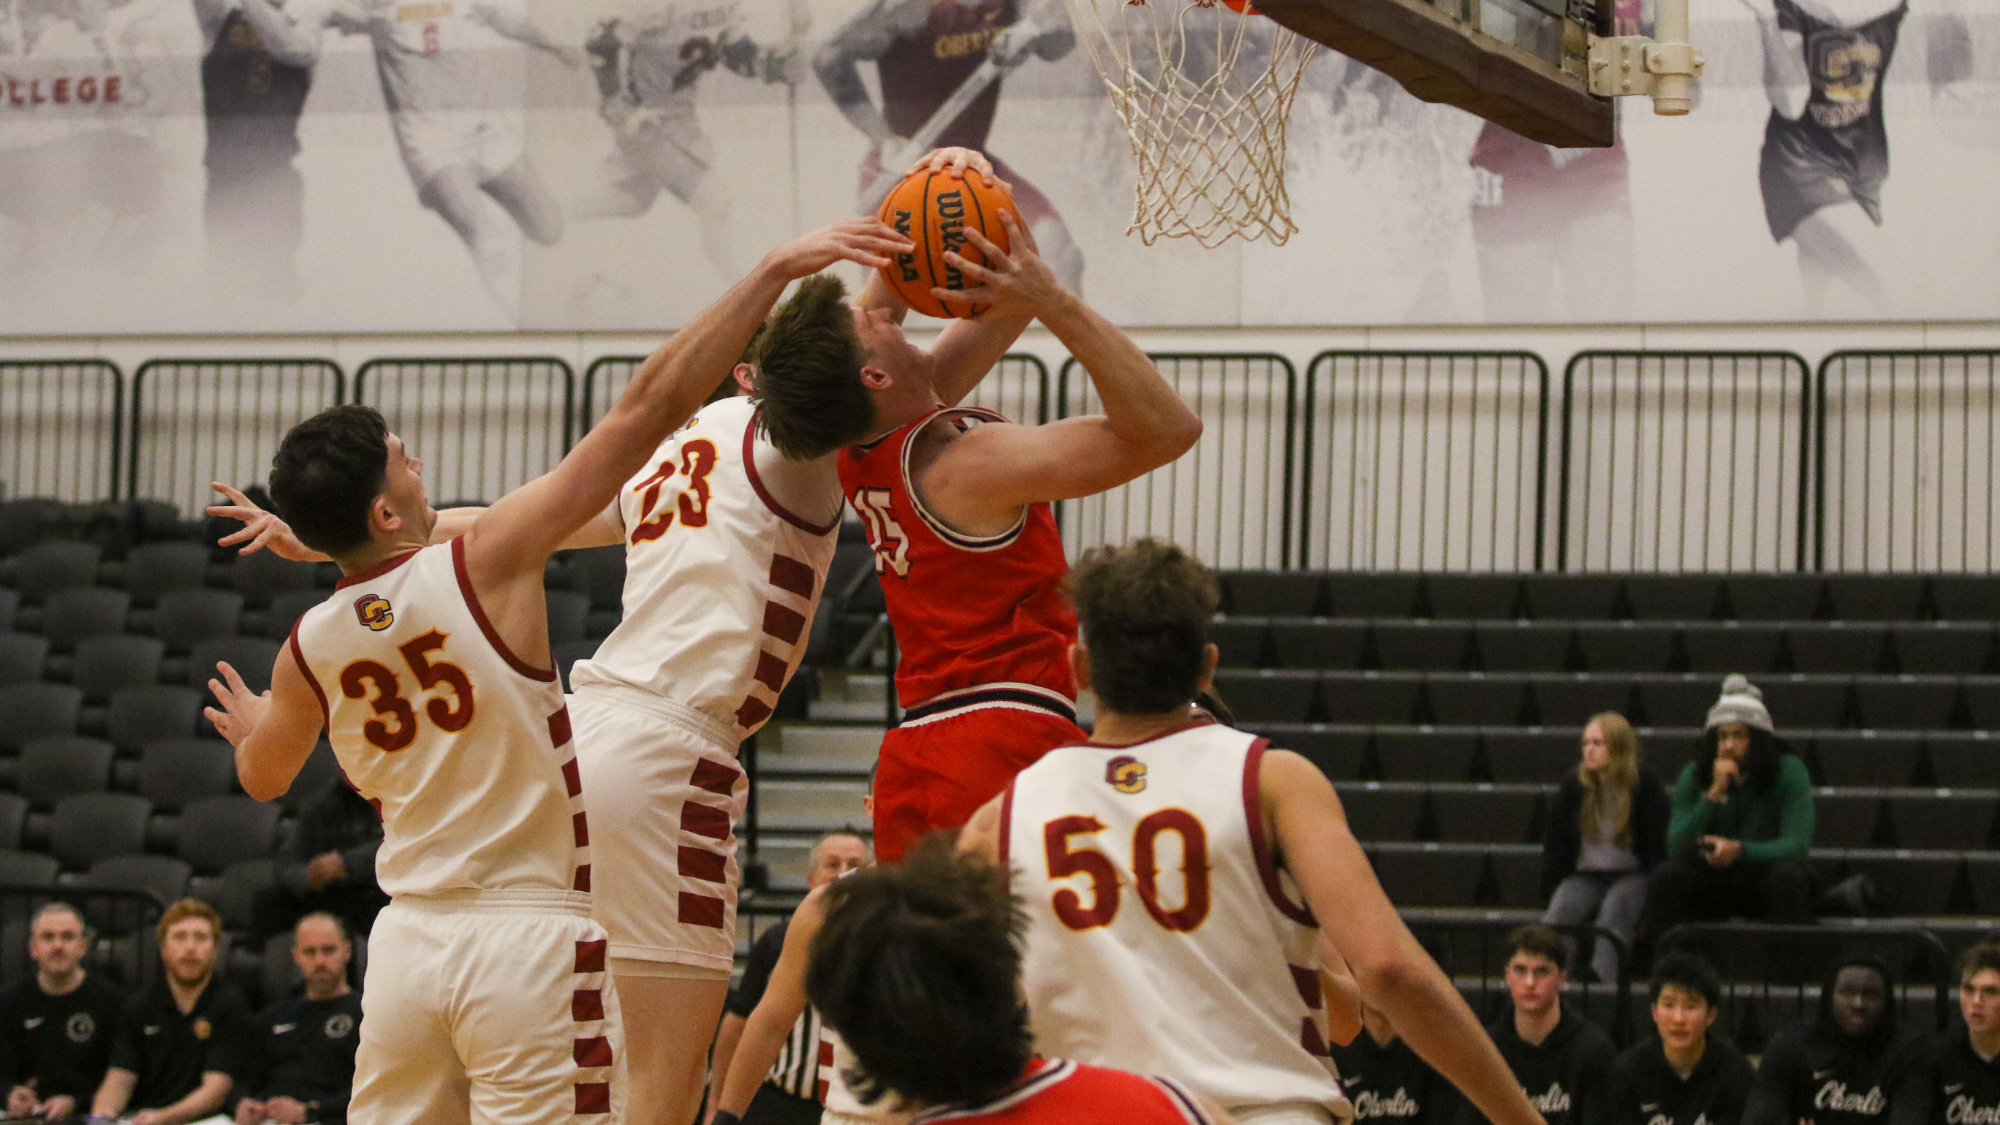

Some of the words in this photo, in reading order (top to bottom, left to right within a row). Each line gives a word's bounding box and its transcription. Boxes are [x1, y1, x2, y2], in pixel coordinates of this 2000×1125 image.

[0, 76, 121, 103] LLEGE
[936, 190, 969, 290] Wilsn
[631, 437, 731, 546] 23
[854, 486, 912, 579] 15
[339, 626, 475, 752] 35
[1042, 806, 1213, 935] 50
[1354, 1086, 1419, 1120] Oberlin
